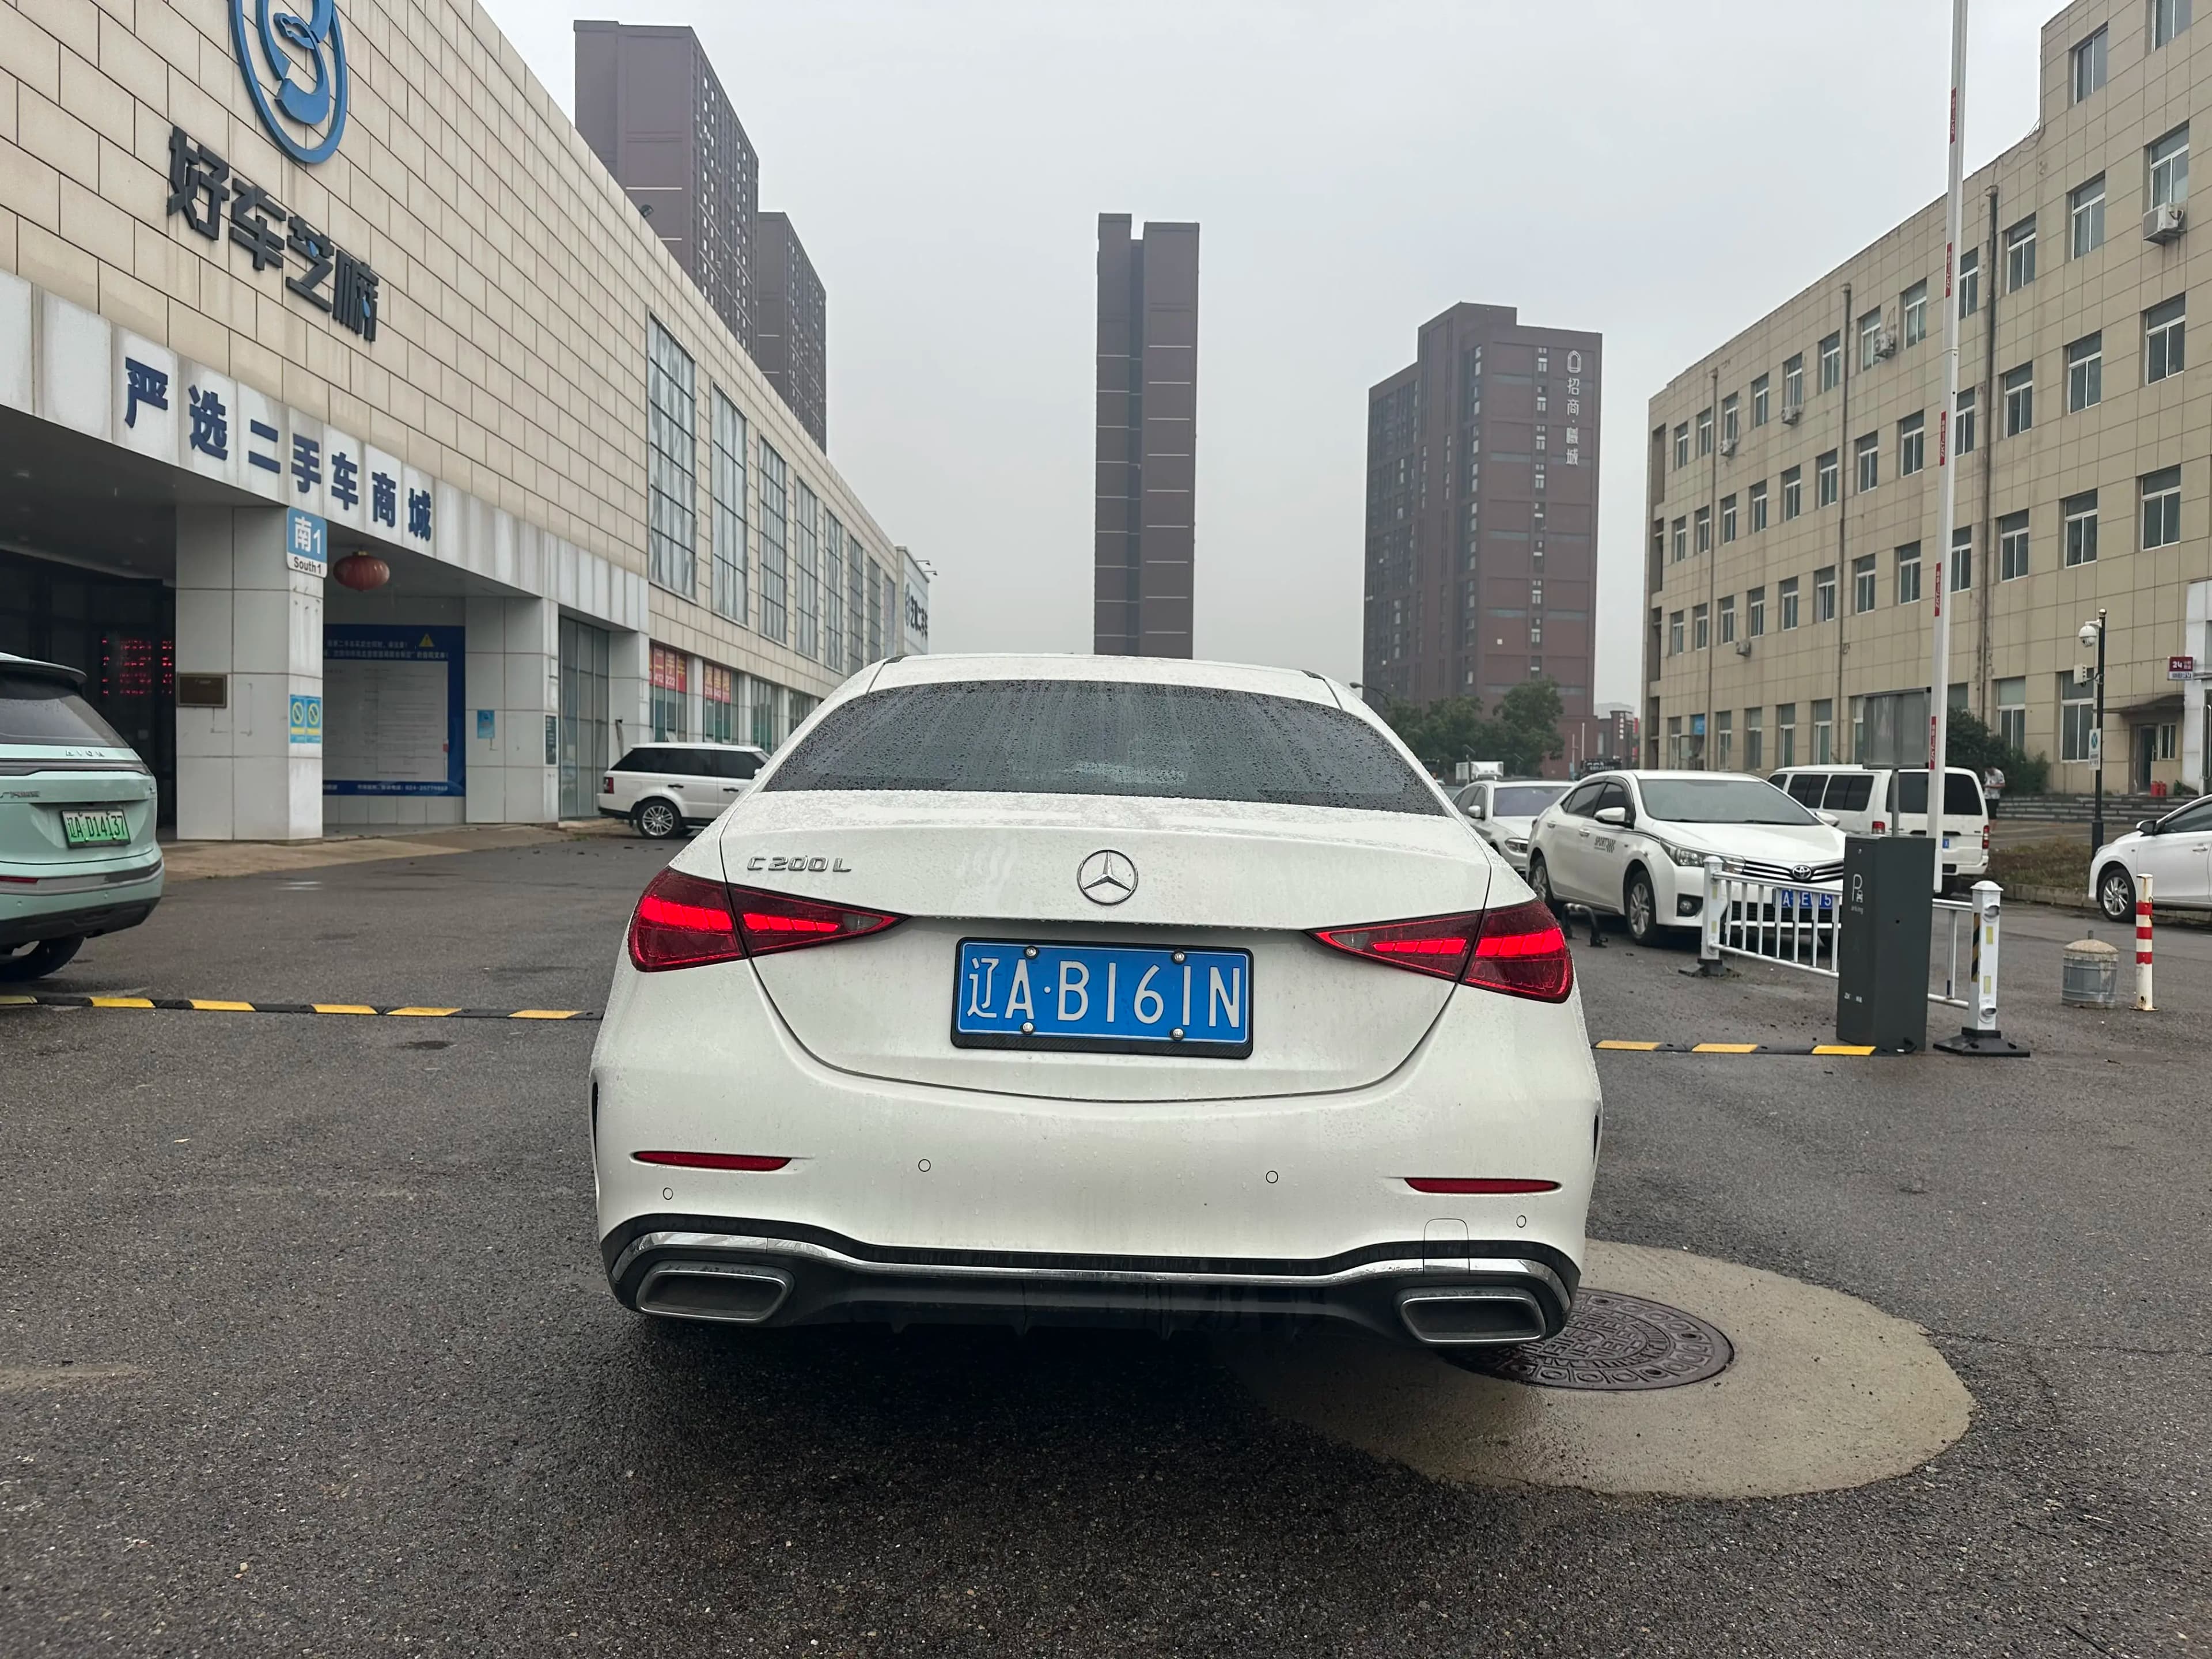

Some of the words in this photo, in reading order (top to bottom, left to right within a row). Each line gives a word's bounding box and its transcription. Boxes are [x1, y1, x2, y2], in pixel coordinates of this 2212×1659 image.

[125, 357, 431, 541] 严选二手车商城
[294, 516, 321, 554] 南1
[967, 957, 1240, 1028] 辽A·B161N
